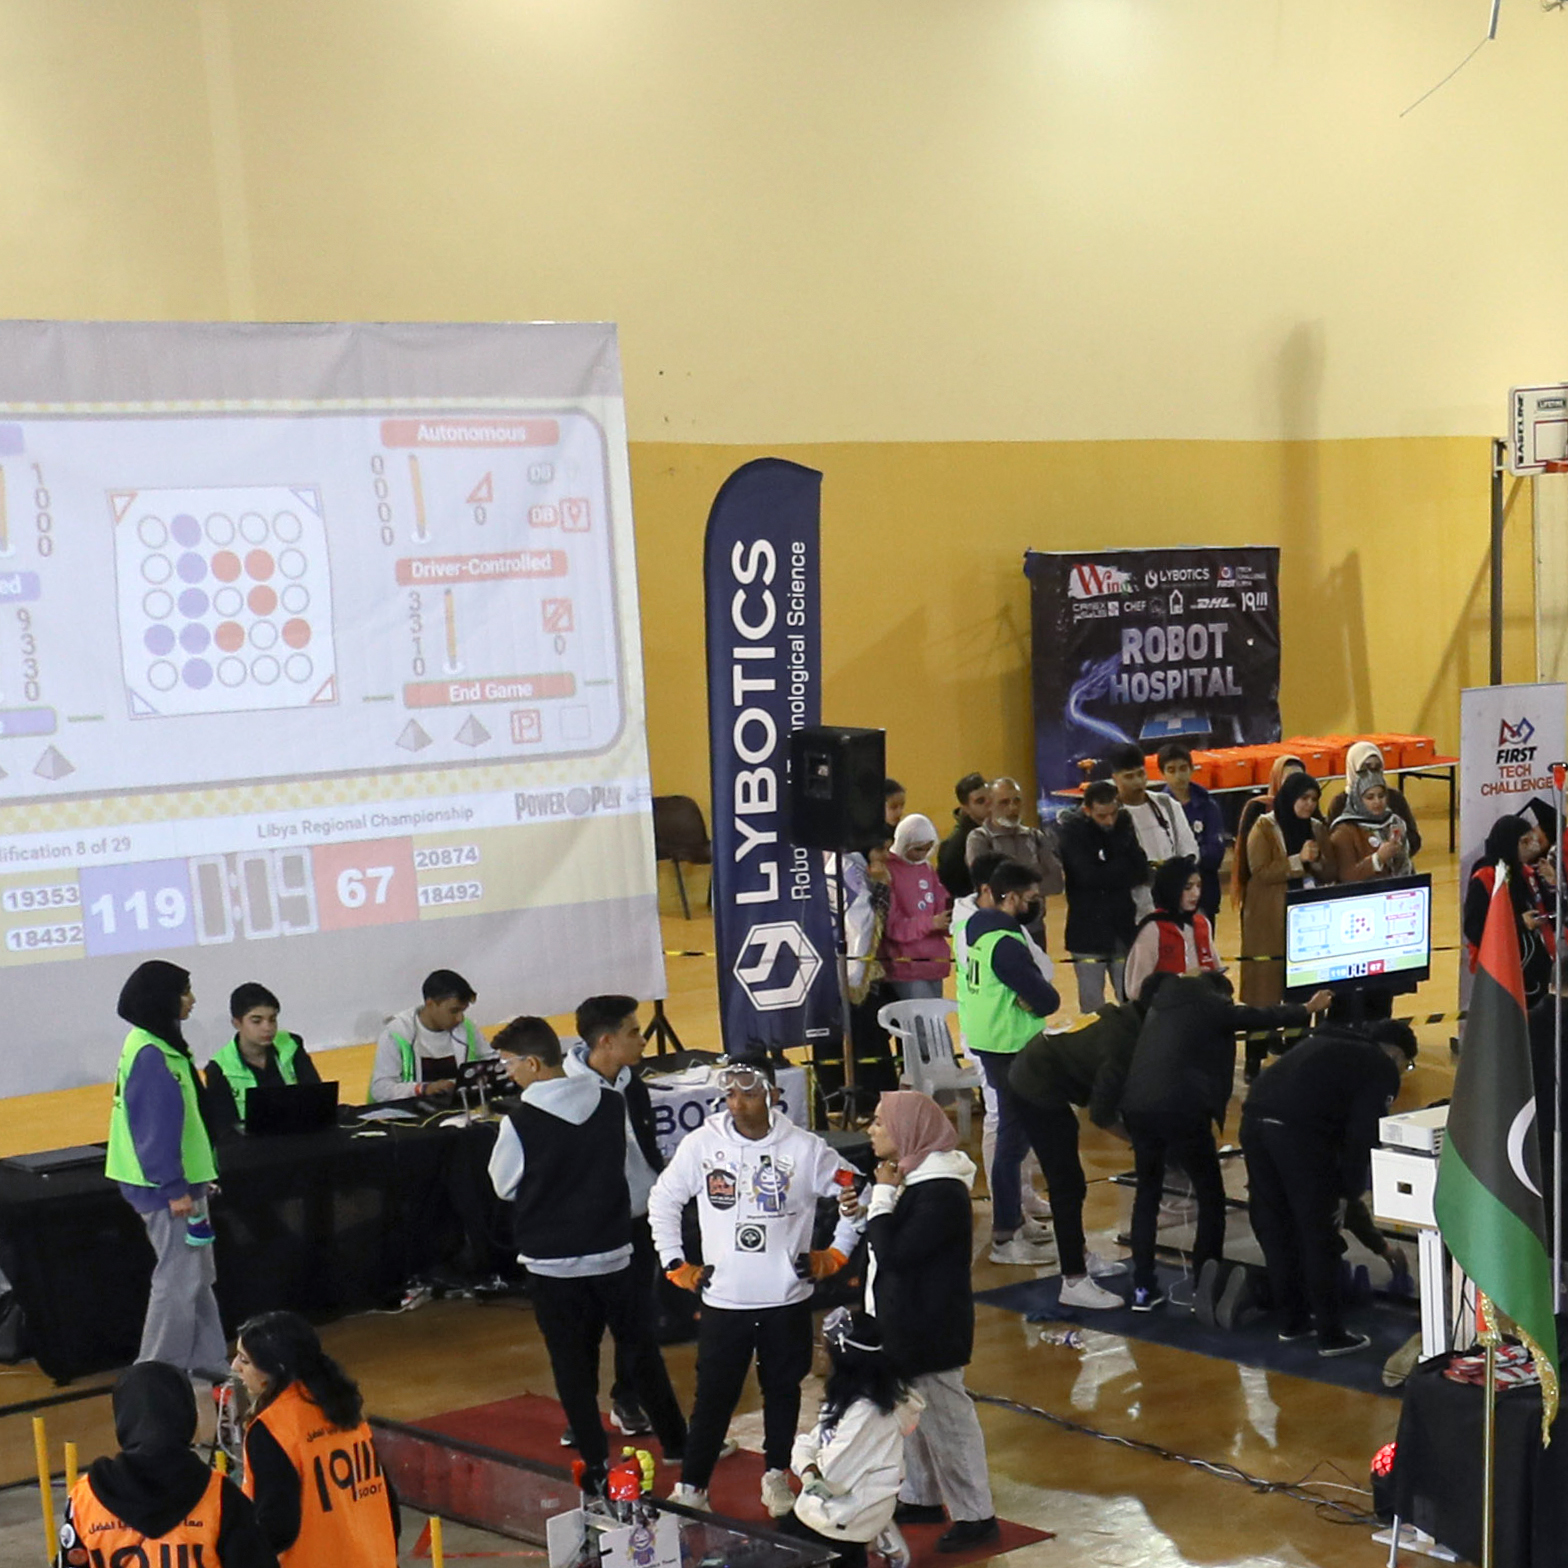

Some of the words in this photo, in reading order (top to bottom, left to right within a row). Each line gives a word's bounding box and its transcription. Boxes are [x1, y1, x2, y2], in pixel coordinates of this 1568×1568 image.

[417, 424, 527, 443] Autonomous
[411, 554, 553, 579] Driver-Controlled
[1159, 568, 1210, 582] LYBOTICS
[786, 540, 807, 626] Science
[1124, 600, 1147, 612] CHEF
[1196, 597, 1230, 609] DHL
[1121, 623, 1229, 665] ROBOT
[449, 684, 480, 704] End
[485, 680, 534, 700] Game
[1110, 666, 1242, 704] HOSPITAL
[731, 538, 780, 904] LYBOTICS
[1496, 746, 1537, 765] FIRST
[1498, 764, 1532, 779] TECH
[1481, 777, 1554, 796] CHALLENGE
[257, 822, 298, 840] Libya
[302, 815, 368, 837] Regional
[370, 807, 475, 831] Championship
[76, 842, 87, 855] 8
[90, 838, 107, 853] of
[111, 836, 132, 852] 29
[416, 847, 479, 868] 20874
[787, 842, 811, 901] Robo
[6, 887, 79, 910] 19353
[91, 887, 187, 934] 119
[337, 867, 395, 909] 67
[419, 884, 481, 905] 18492
[11, 926, 84, 949] 18432
